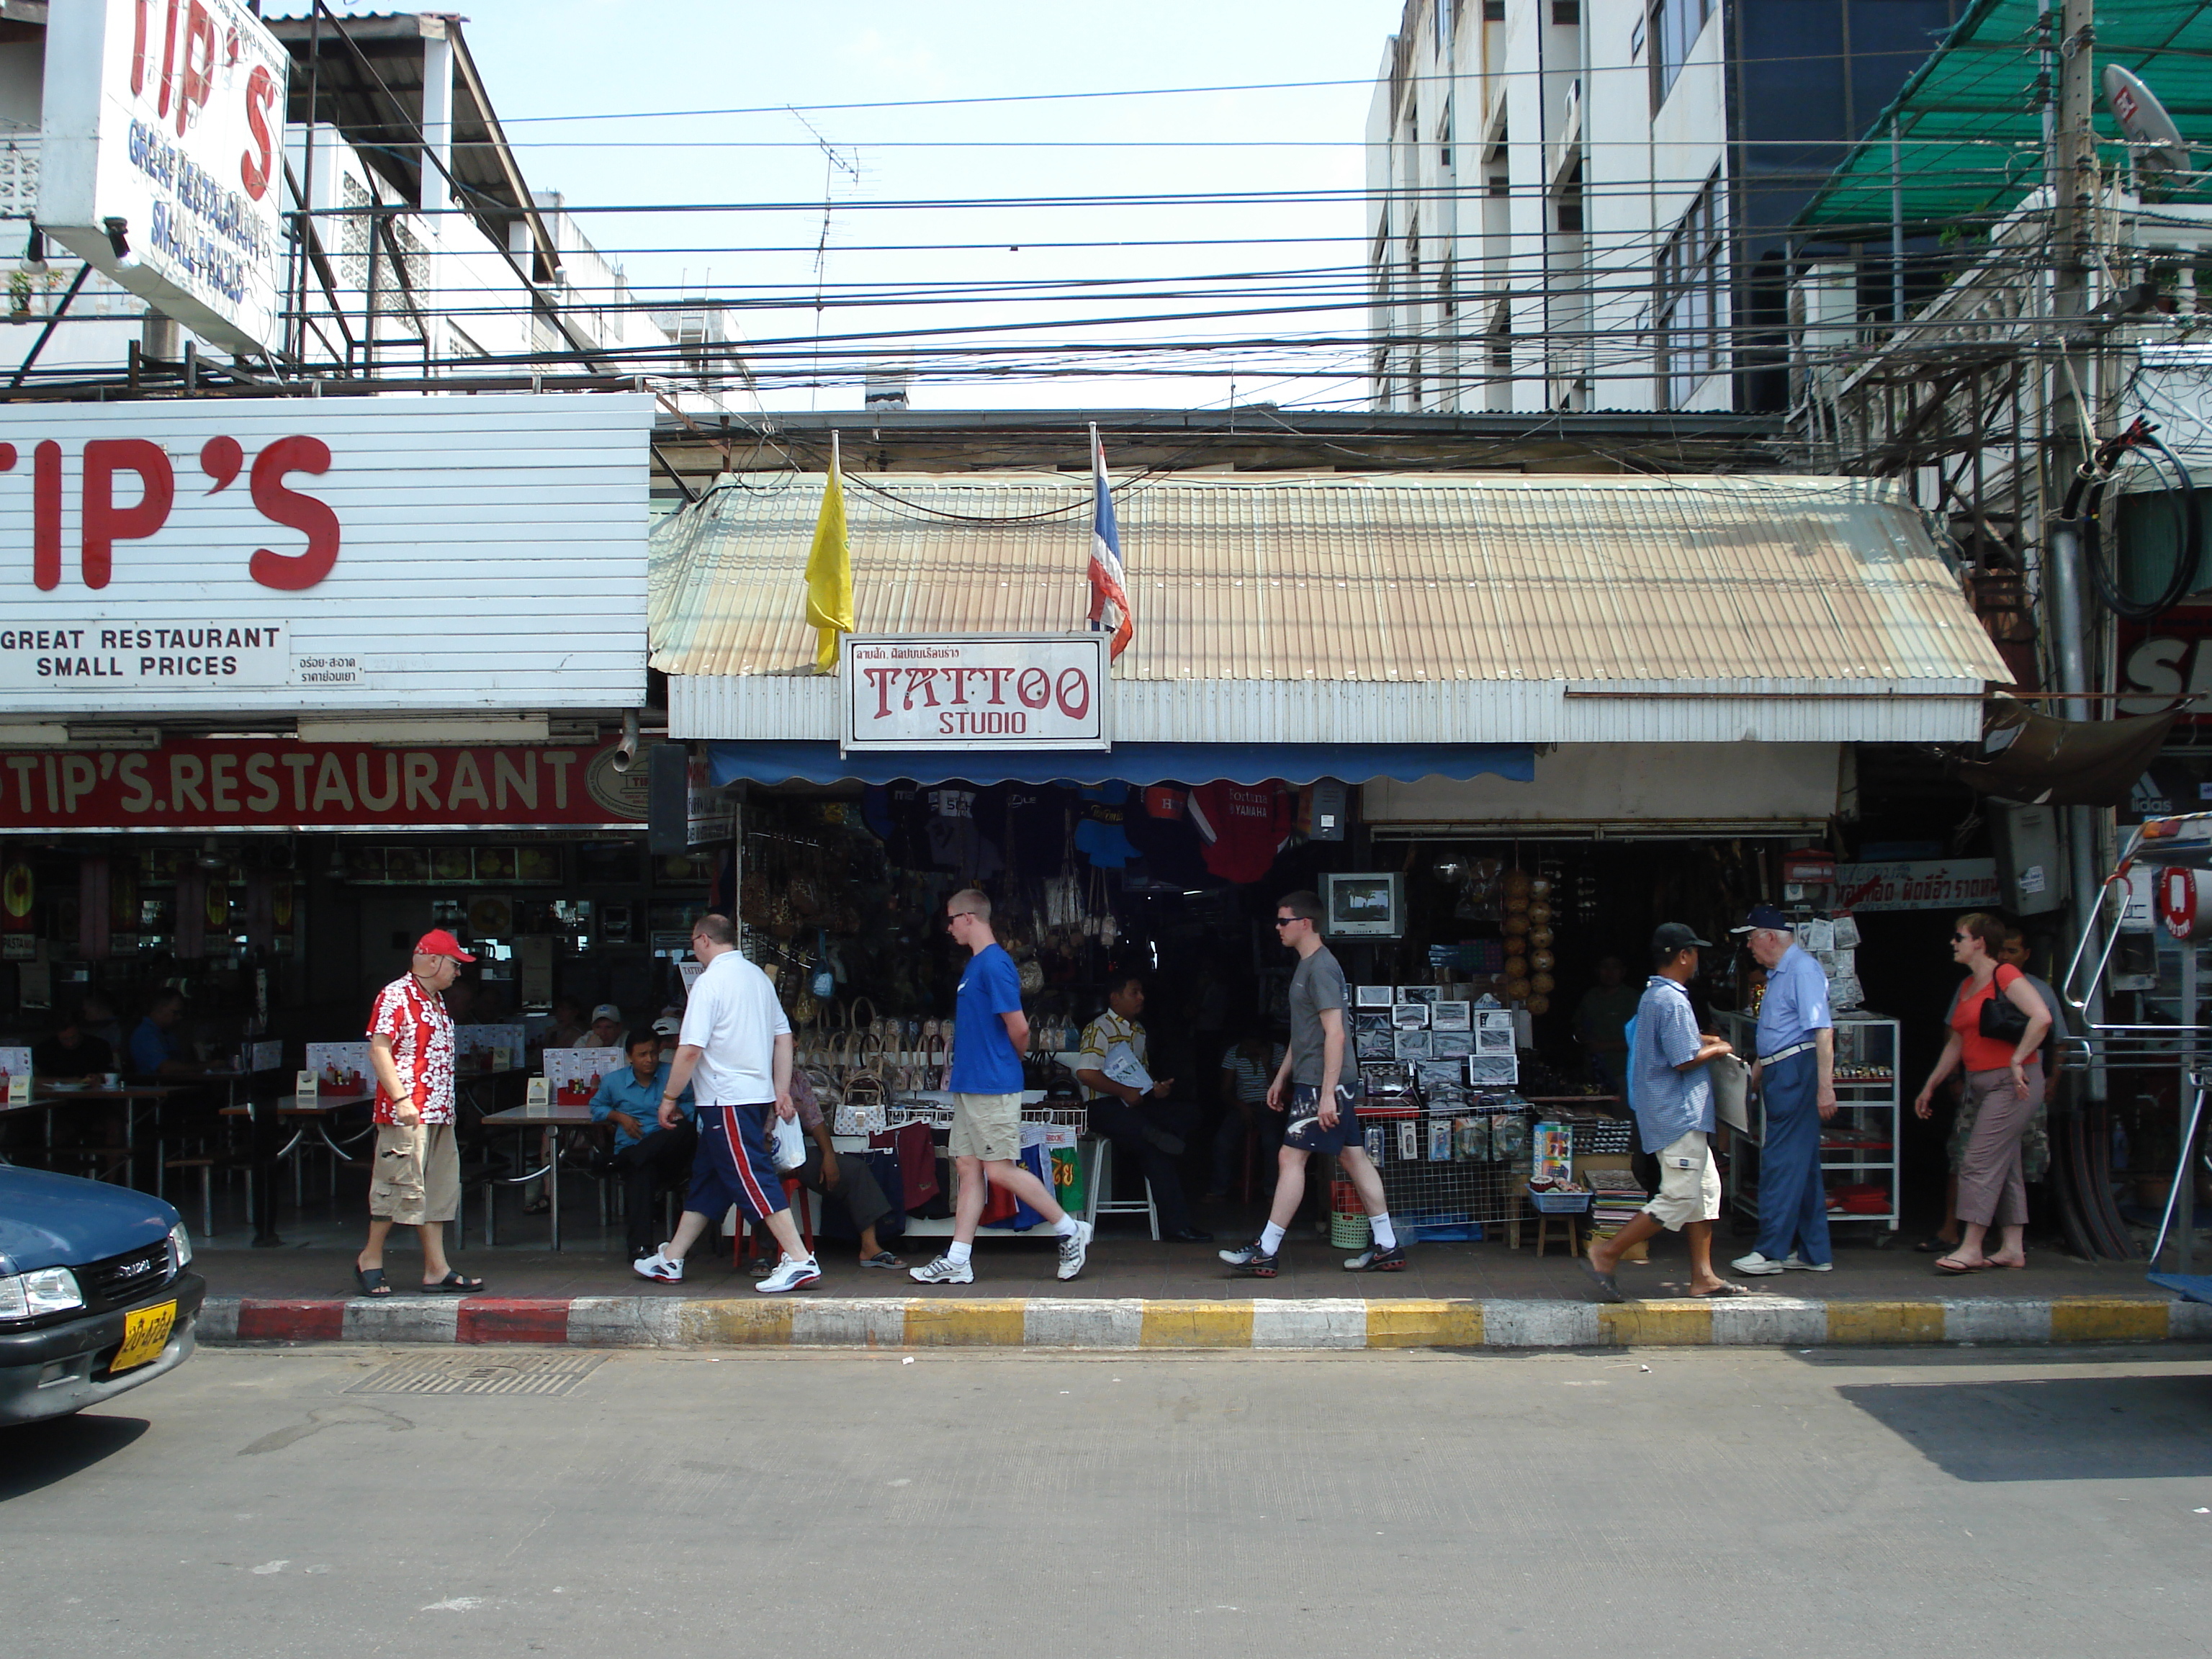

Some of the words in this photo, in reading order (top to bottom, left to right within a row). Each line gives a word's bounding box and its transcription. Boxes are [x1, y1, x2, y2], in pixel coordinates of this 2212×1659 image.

[0, 435, 341, 590] IP'S
[1, 630, 84, 650] GREAT
[101, 627, 279, 649] RESTAURANT
[37, 657, 123, 676] SMALL
[140, 656, 238, 675] PRICES
[863, 667, 1089, 720] TATTOO
[939, 711, 1027, 734] STUDIO
[1236, 804, 1267, 818] YAMAHA
